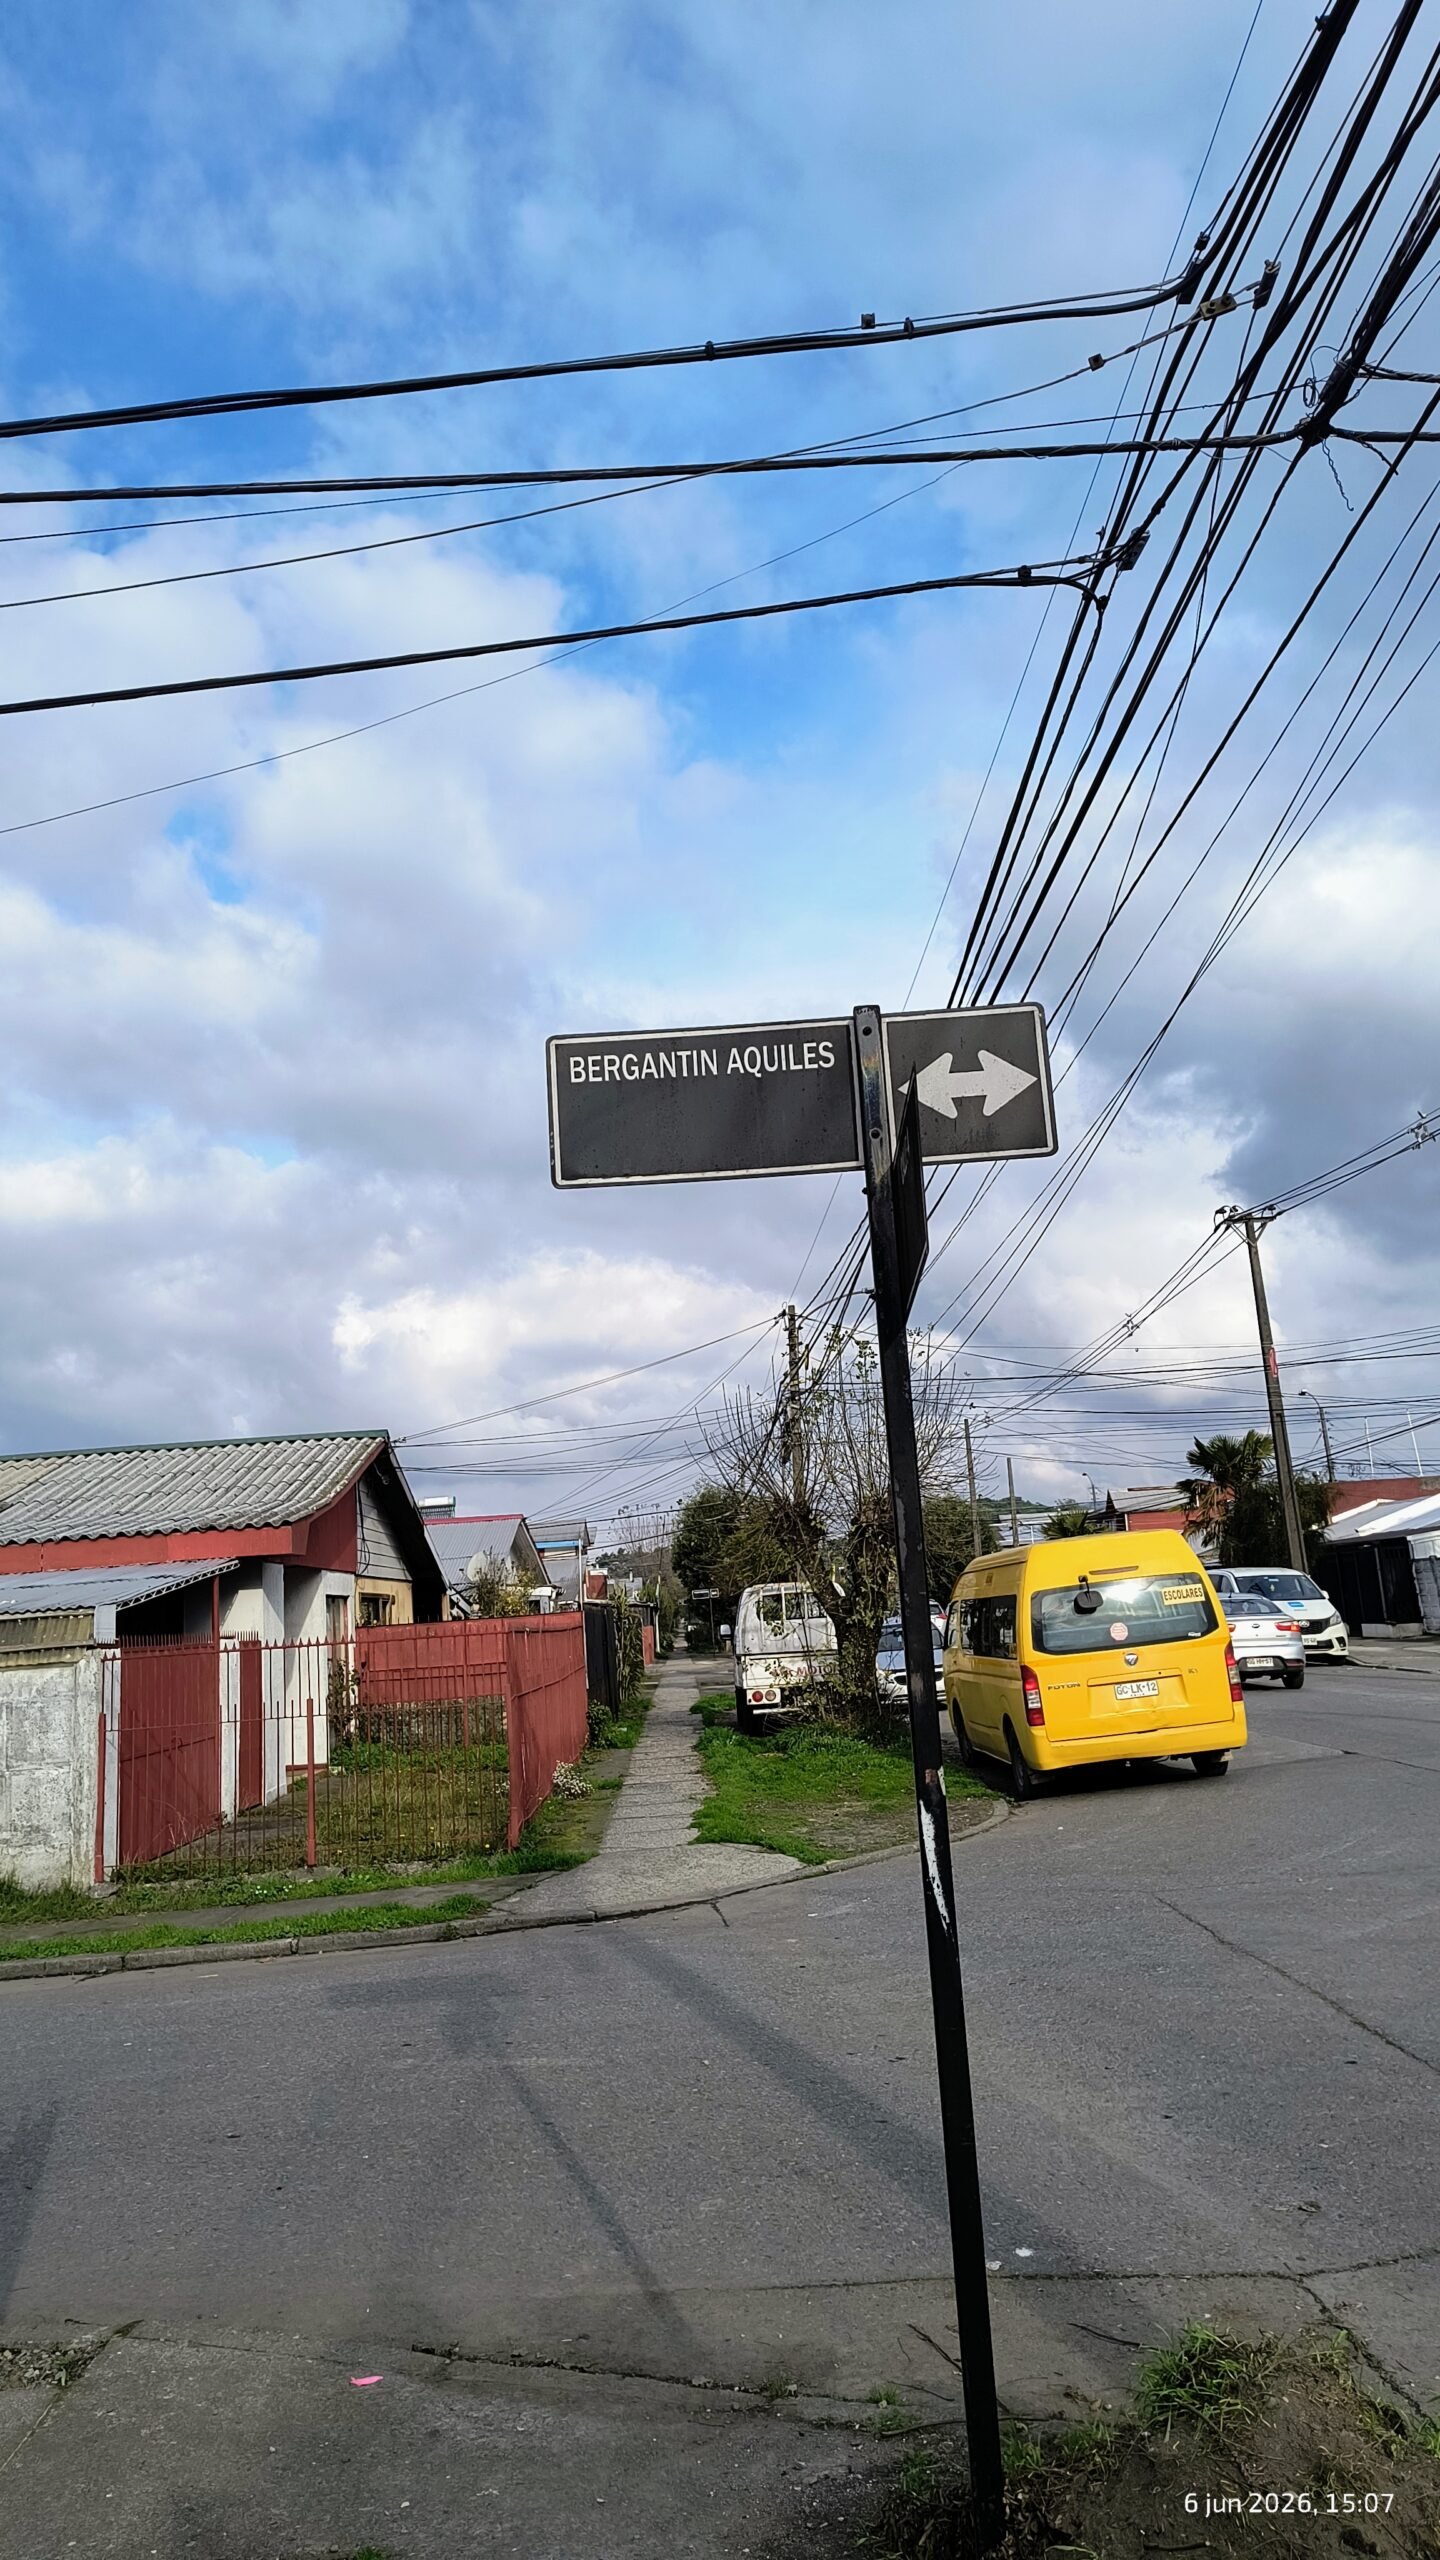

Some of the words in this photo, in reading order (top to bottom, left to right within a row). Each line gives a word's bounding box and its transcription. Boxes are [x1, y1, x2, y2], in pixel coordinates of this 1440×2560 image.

[569, 1048, 718, 1083] BERGANTIN
[726, 1041, 835, 1077] AQUILES
[1163, 1587, 1203, 1601] ESCOLARES
